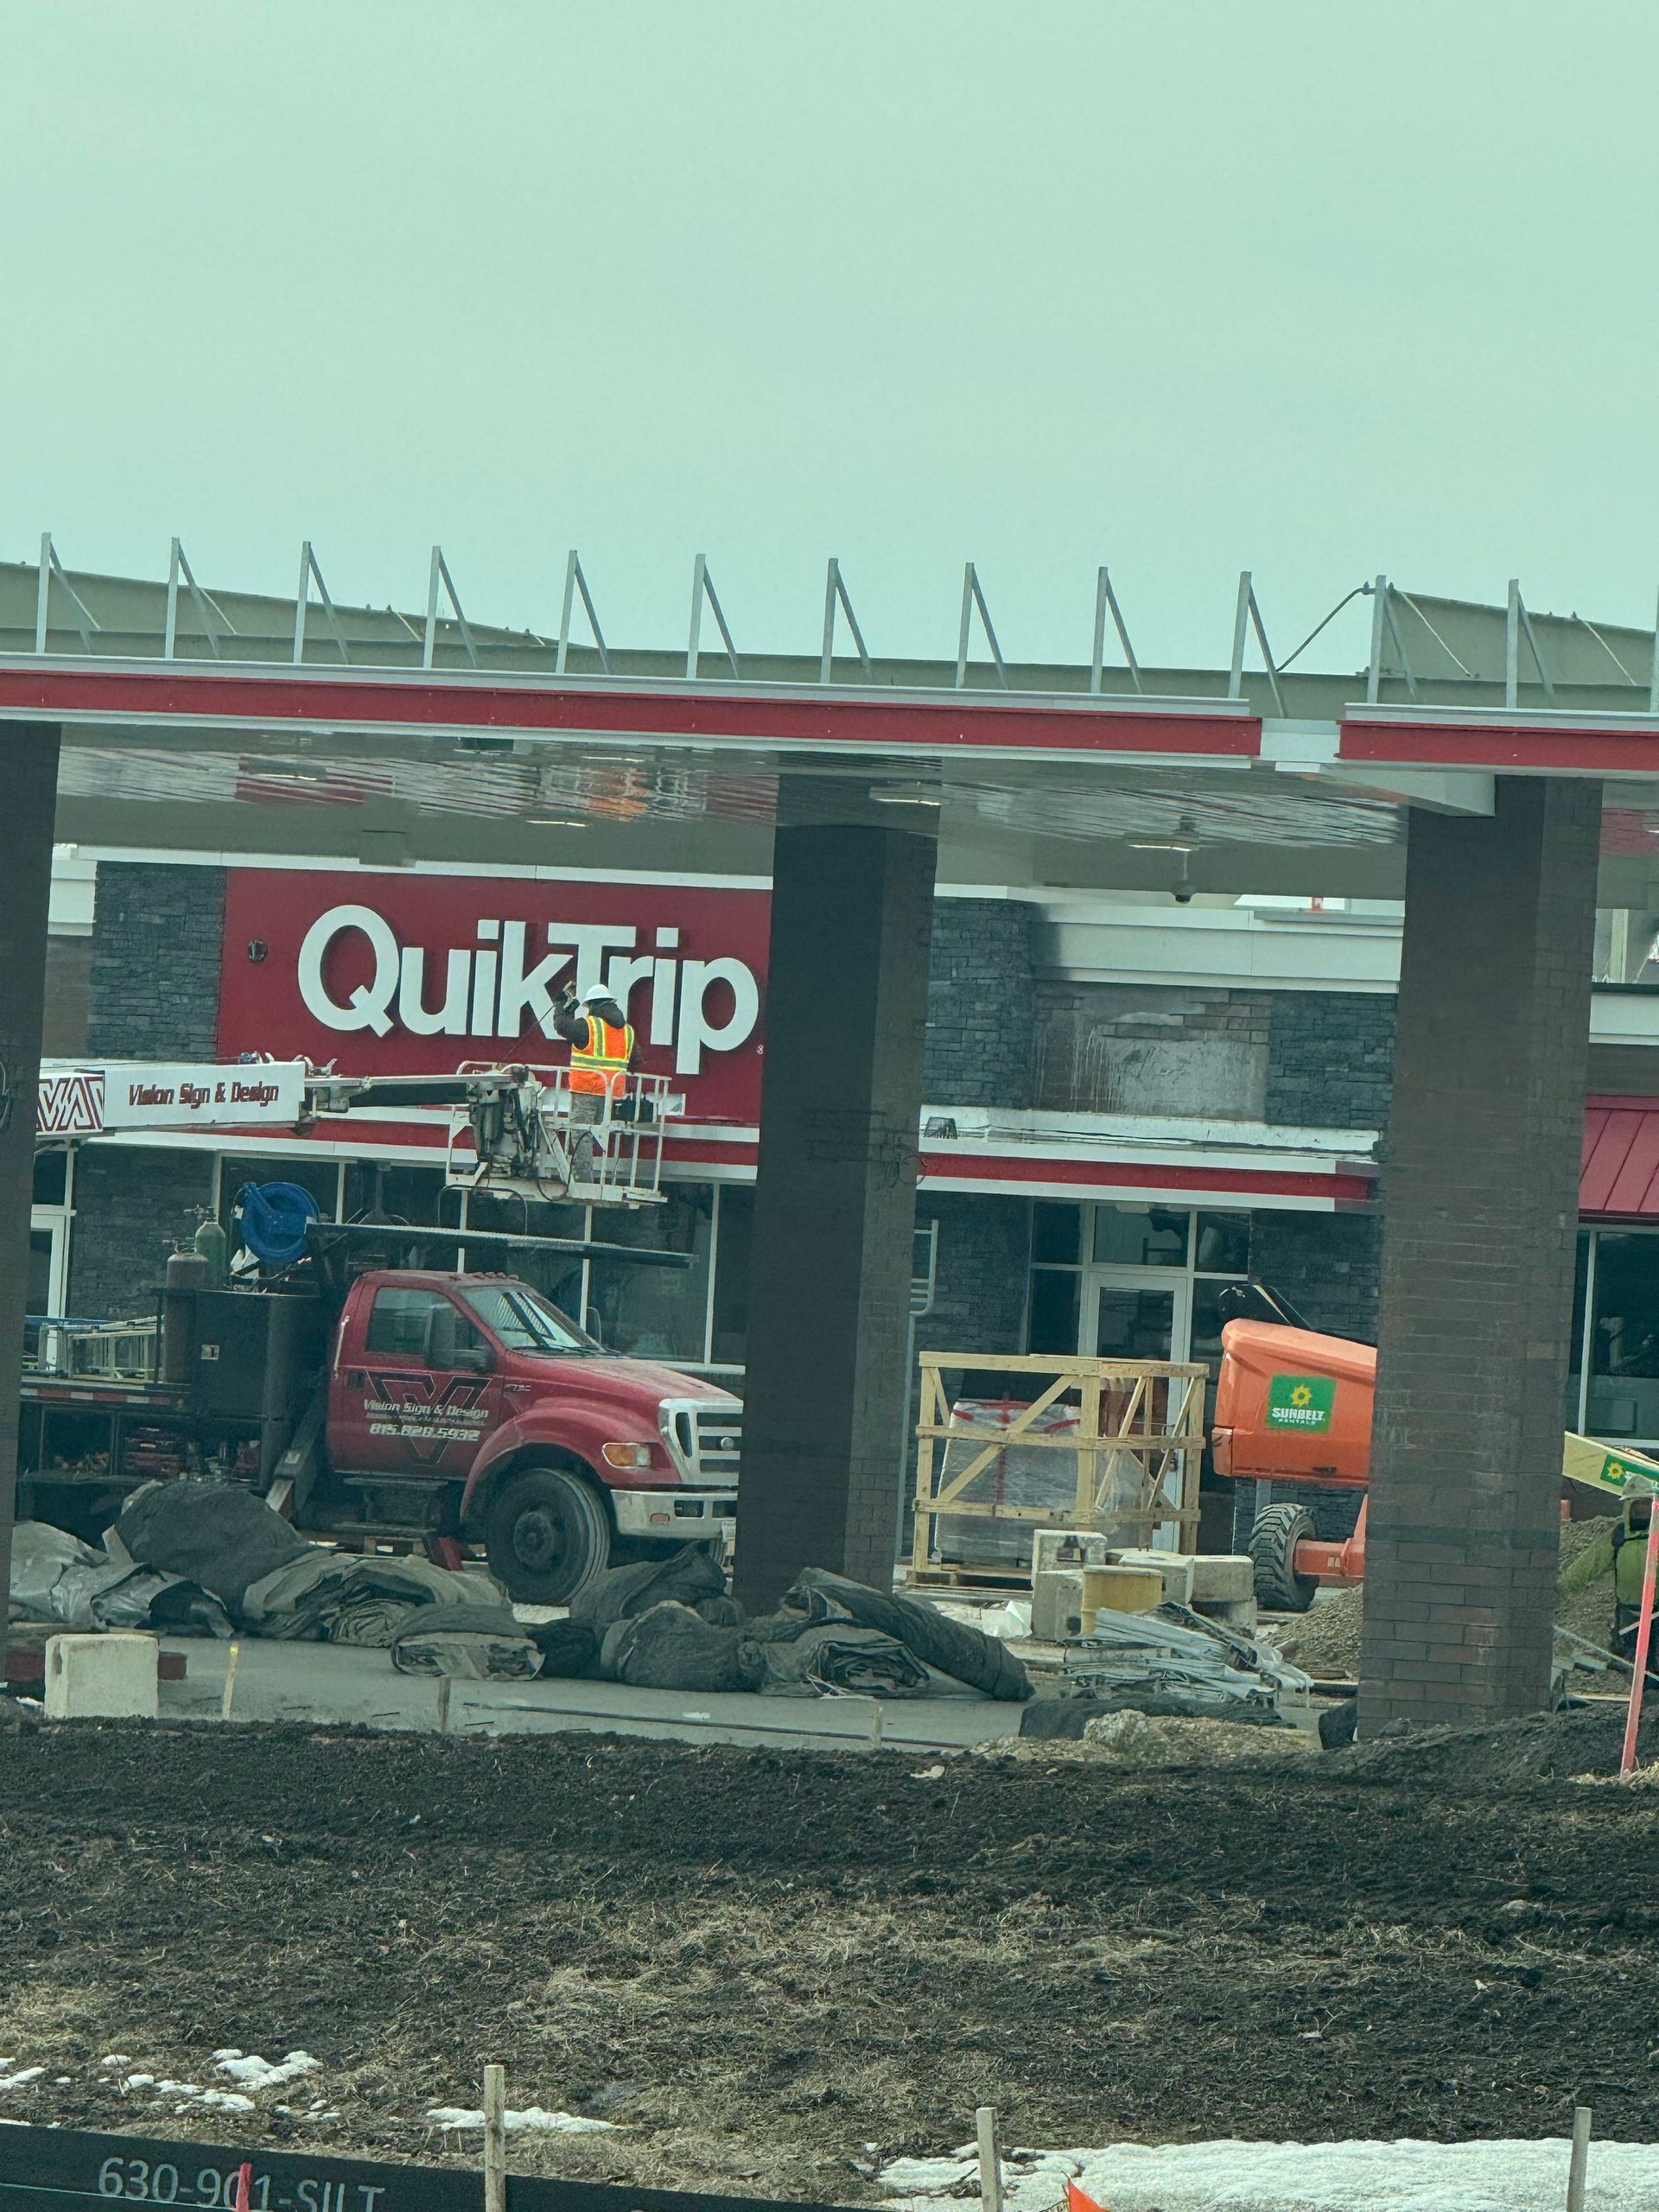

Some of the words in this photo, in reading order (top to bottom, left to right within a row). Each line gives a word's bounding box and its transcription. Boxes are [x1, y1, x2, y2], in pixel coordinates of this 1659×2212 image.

[298, 905, 759, 1075] QuikTrip
[129, 1084, 175, 1106] Vision
[179, 1083, 211, 1109] Sign
[214, 1082, 226, 1103] &
[230, 1081, 279, 1108] Design
[364, 1399, 401, 1412] Vision
[403, 1402, 431, 1415] Sign
[434, 1404, 443, 1415] &
[446, 1406, 489, 1420] Design
[1272, 1407, 1325, 1421] SUNBELT
